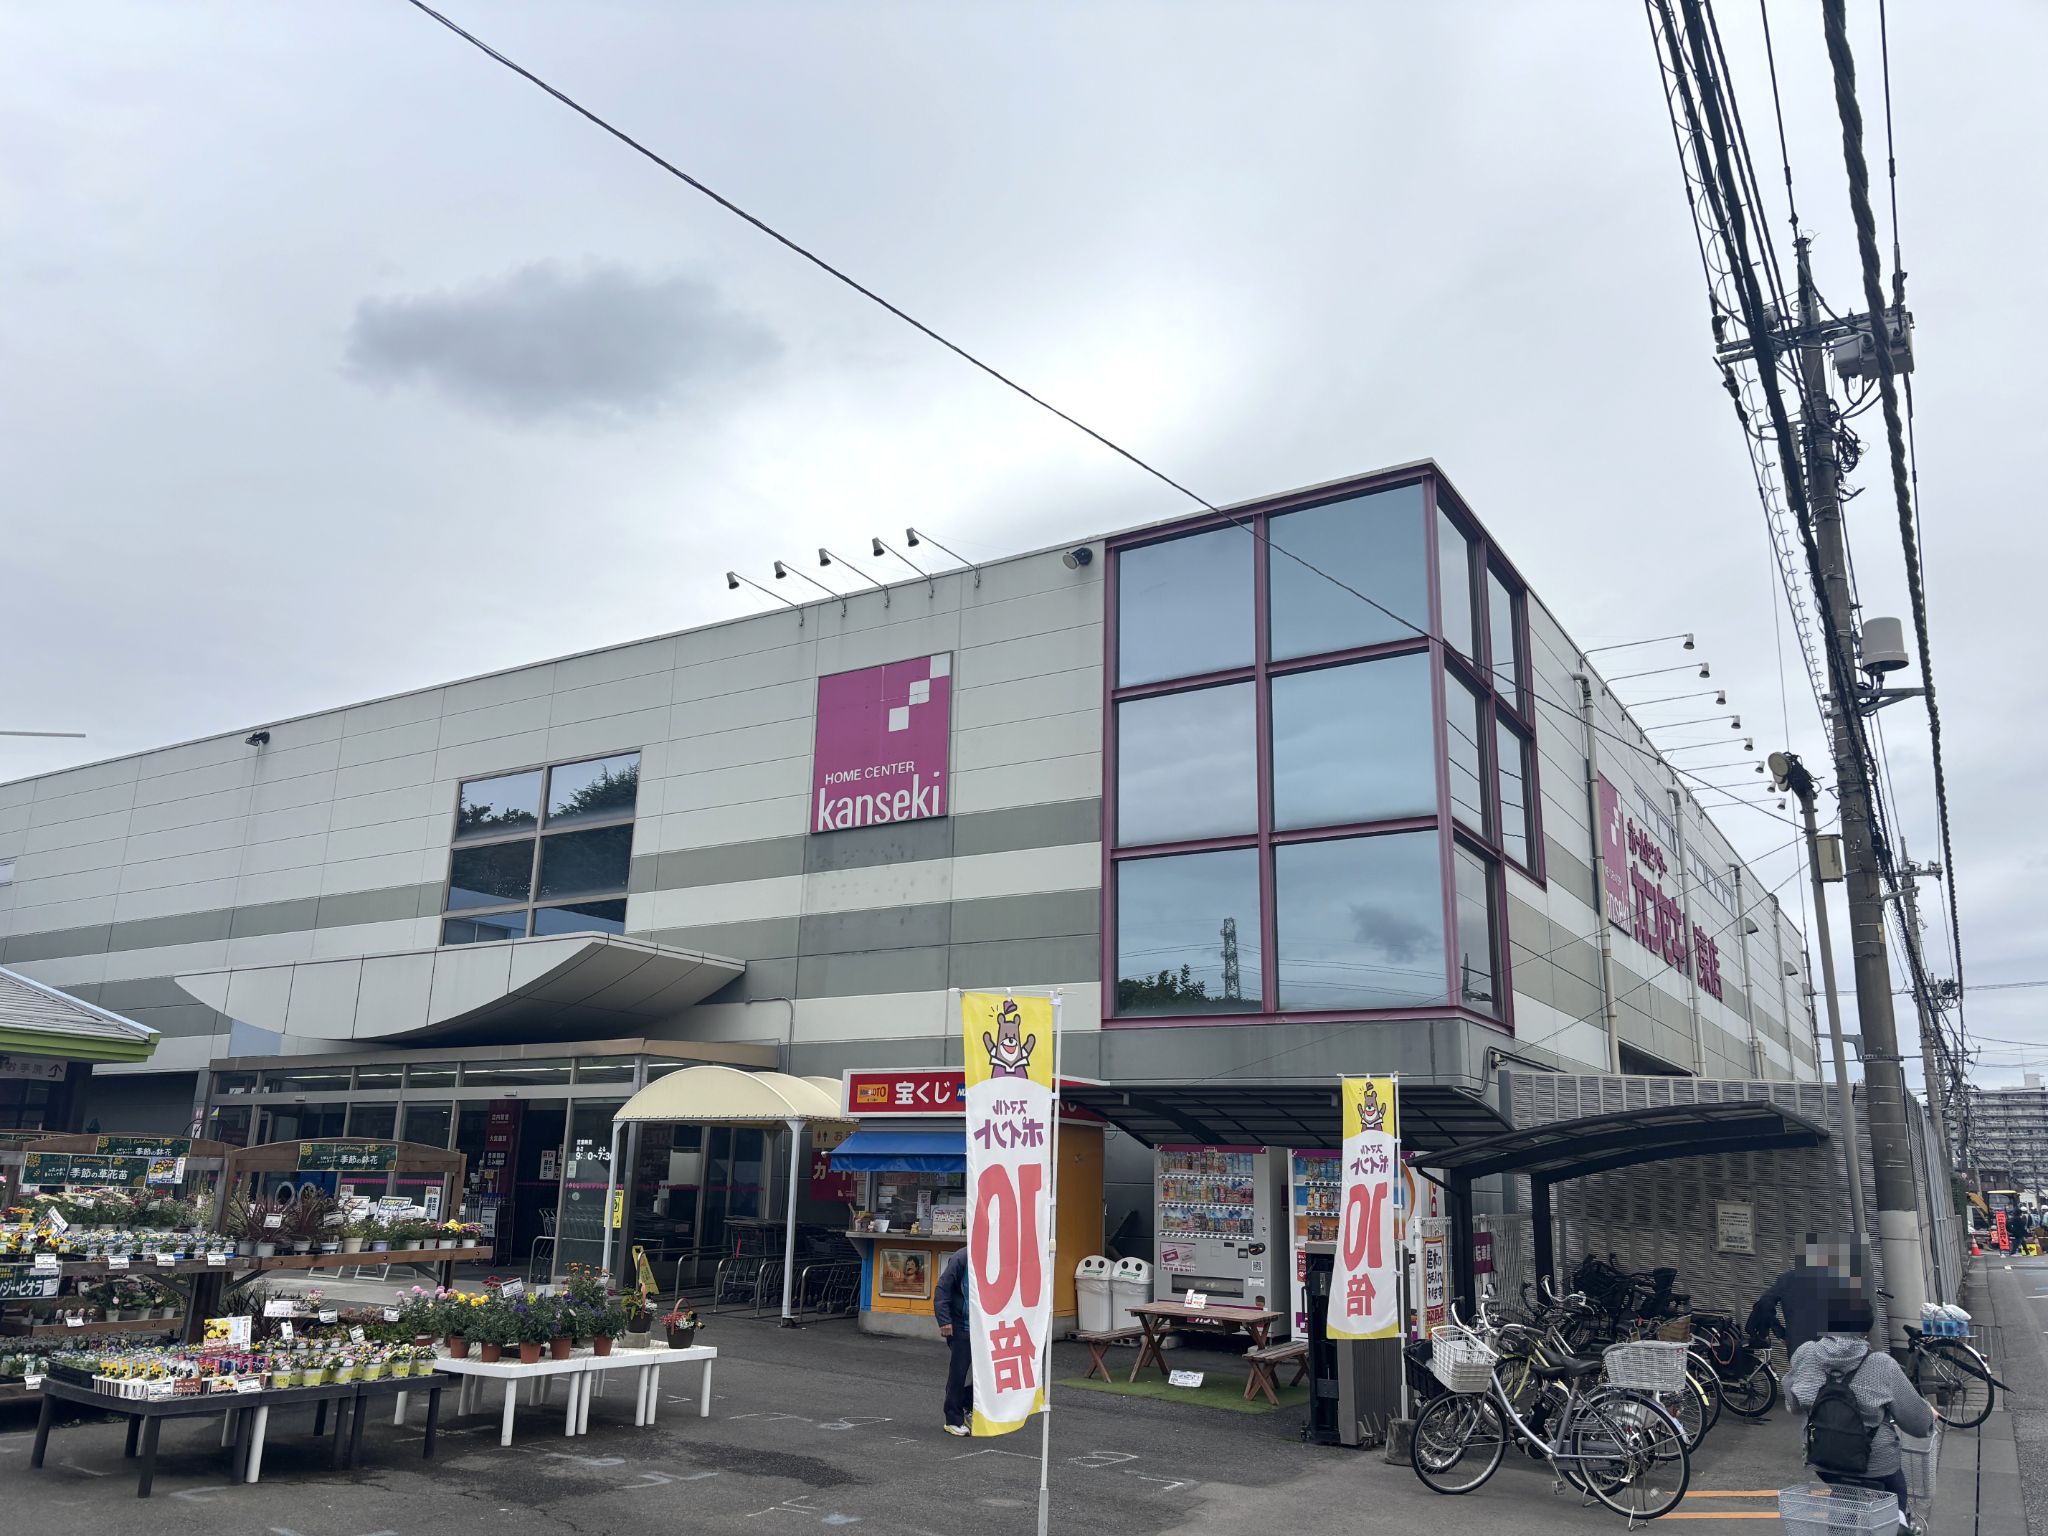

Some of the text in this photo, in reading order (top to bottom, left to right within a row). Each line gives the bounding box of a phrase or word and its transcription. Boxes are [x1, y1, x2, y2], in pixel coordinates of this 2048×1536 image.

[825, 760, 915, 785] HOME CENTER
[817, 771, 940, 831] kanseki
[895, 1081, 950, 1105] 宝くじ
[69, 1167, 129, 1180] 季節の草花苗
